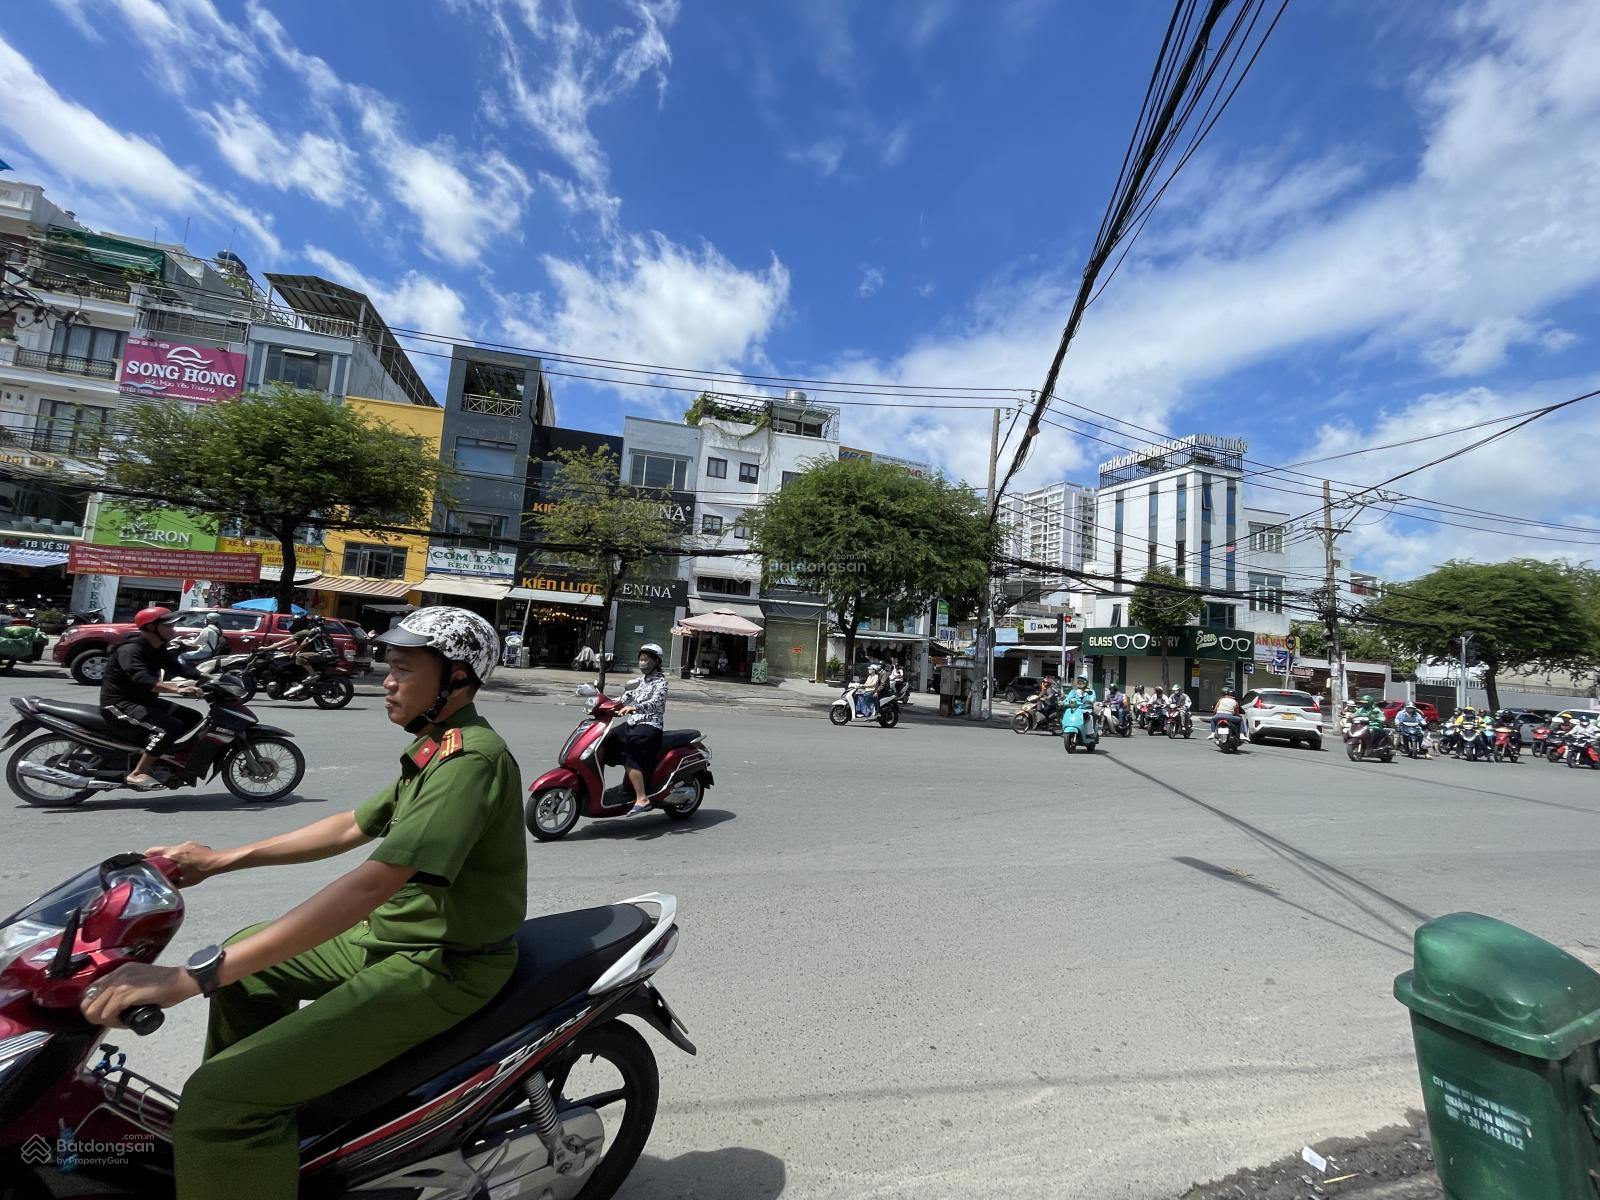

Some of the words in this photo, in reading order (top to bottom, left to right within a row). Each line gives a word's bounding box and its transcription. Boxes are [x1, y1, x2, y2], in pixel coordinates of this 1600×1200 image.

[126, 360, 181, 380] SONG
[182, 368, 237, 388] HONG
[1088, 636, 1113, 647] GLASS
